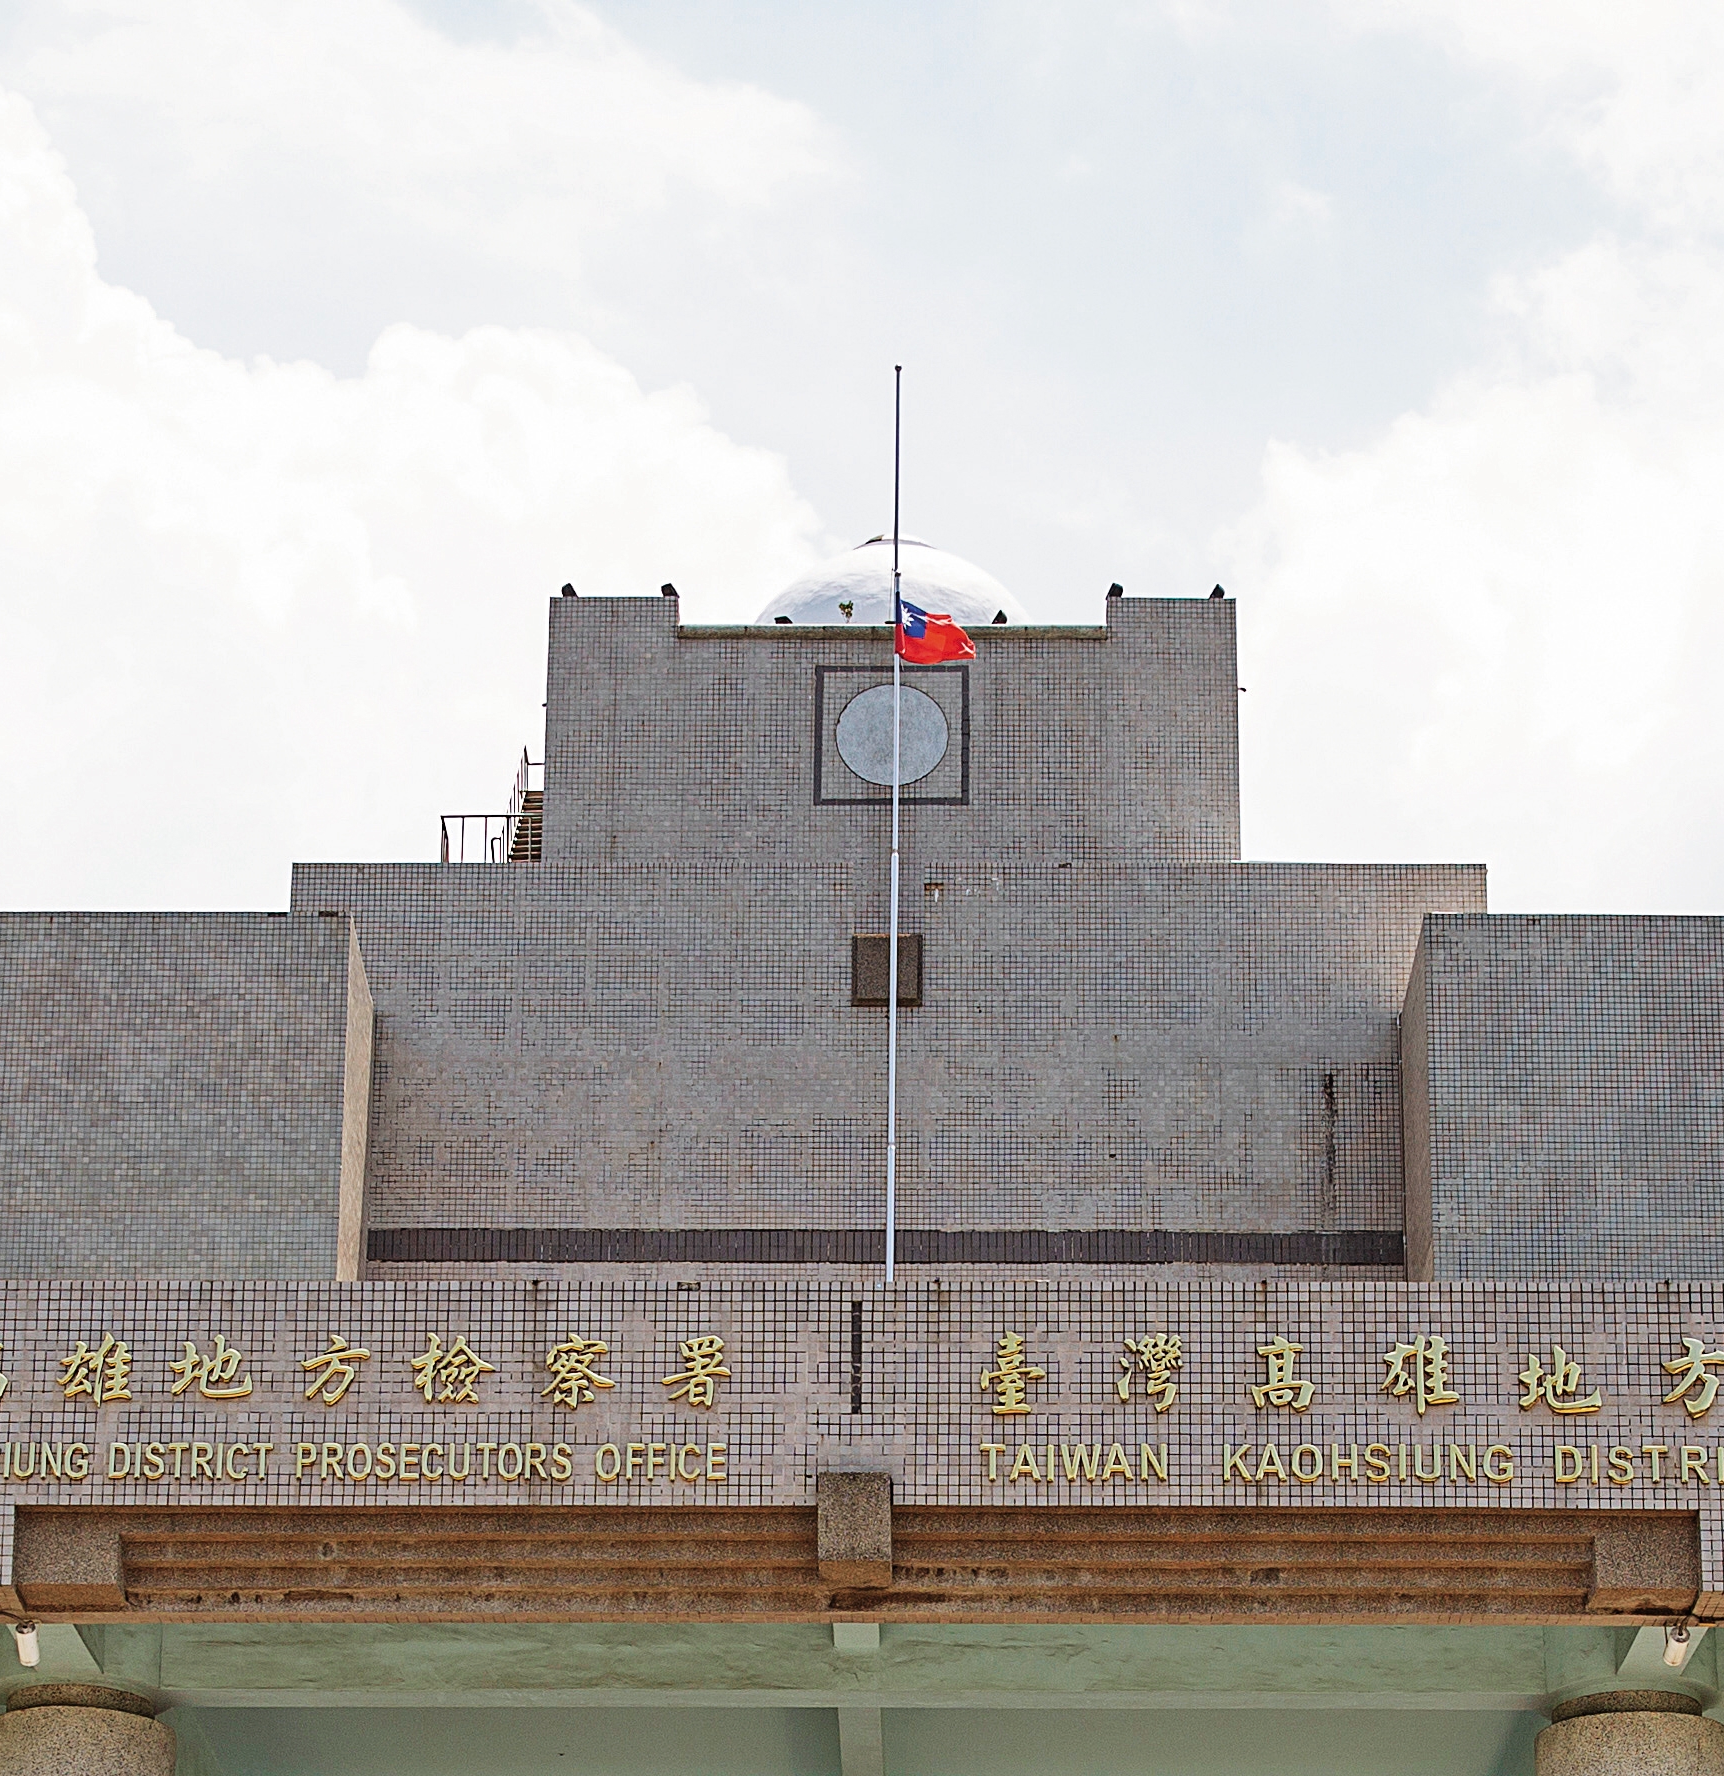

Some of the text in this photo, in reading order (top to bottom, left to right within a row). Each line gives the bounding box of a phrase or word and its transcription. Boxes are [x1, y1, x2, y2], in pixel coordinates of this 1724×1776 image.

[107, 1441, 274, 1481] DISTRICT
[295, 1441, 573, 1482] PROSECUTORS
[595, 1441, 728, 1482] OFFICE
[979, 1442, 1169, 1483] TAIWAN
[1223, 1442, 1516, 1484] KAOHSIUNG
